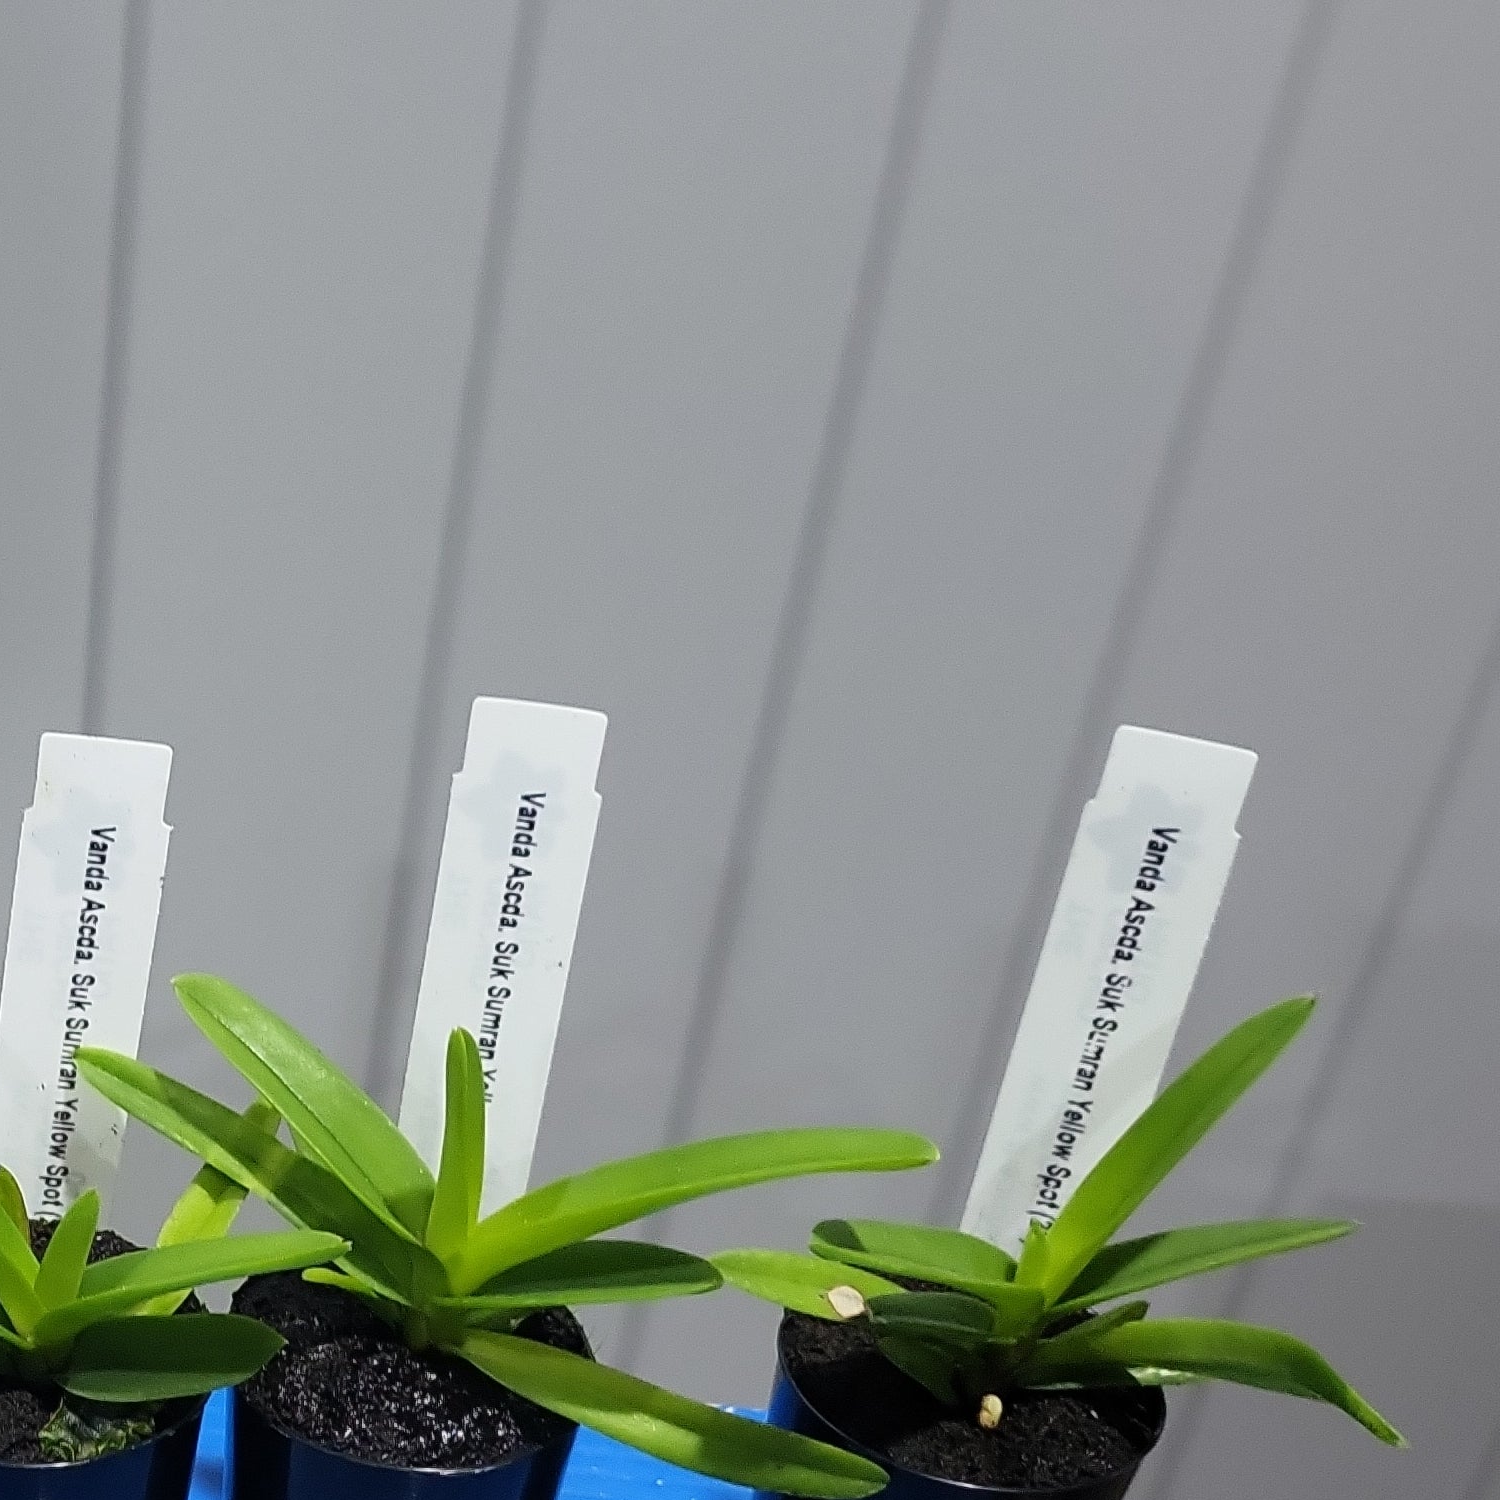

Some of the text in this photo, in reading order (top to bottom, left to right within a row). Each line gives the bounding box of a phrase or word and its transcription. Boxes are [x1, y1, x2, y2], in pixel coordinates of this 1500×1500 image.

[512, 792, 546, 858] Vanda
[84, 826, 117, 891] Vanda
[1135, 827, 1181, 892] Vanda
[73, 896, 105, 964] Ascda.
[498, 864, 532, 932] Ascda.
[1111, 896, 1155, 964] Ascda.
[67, 973, 95, 1011] Suk
[489, 941, 519, 980] Suk
[1097, 973, 1133, 1013] Suk
[57, 1017, 89, 1090] Sumran
[479, 985, 511, 1060] Sumran
[1072, 1017, 1118, 1091] Sumran
[49, 1098, 79, 1160] Yellow
[1052, 1100, 1094, 1161] Yellow
[39, 1164, 69, 1207] Spot
[1037, 1164, 1071, 1209] Spot
